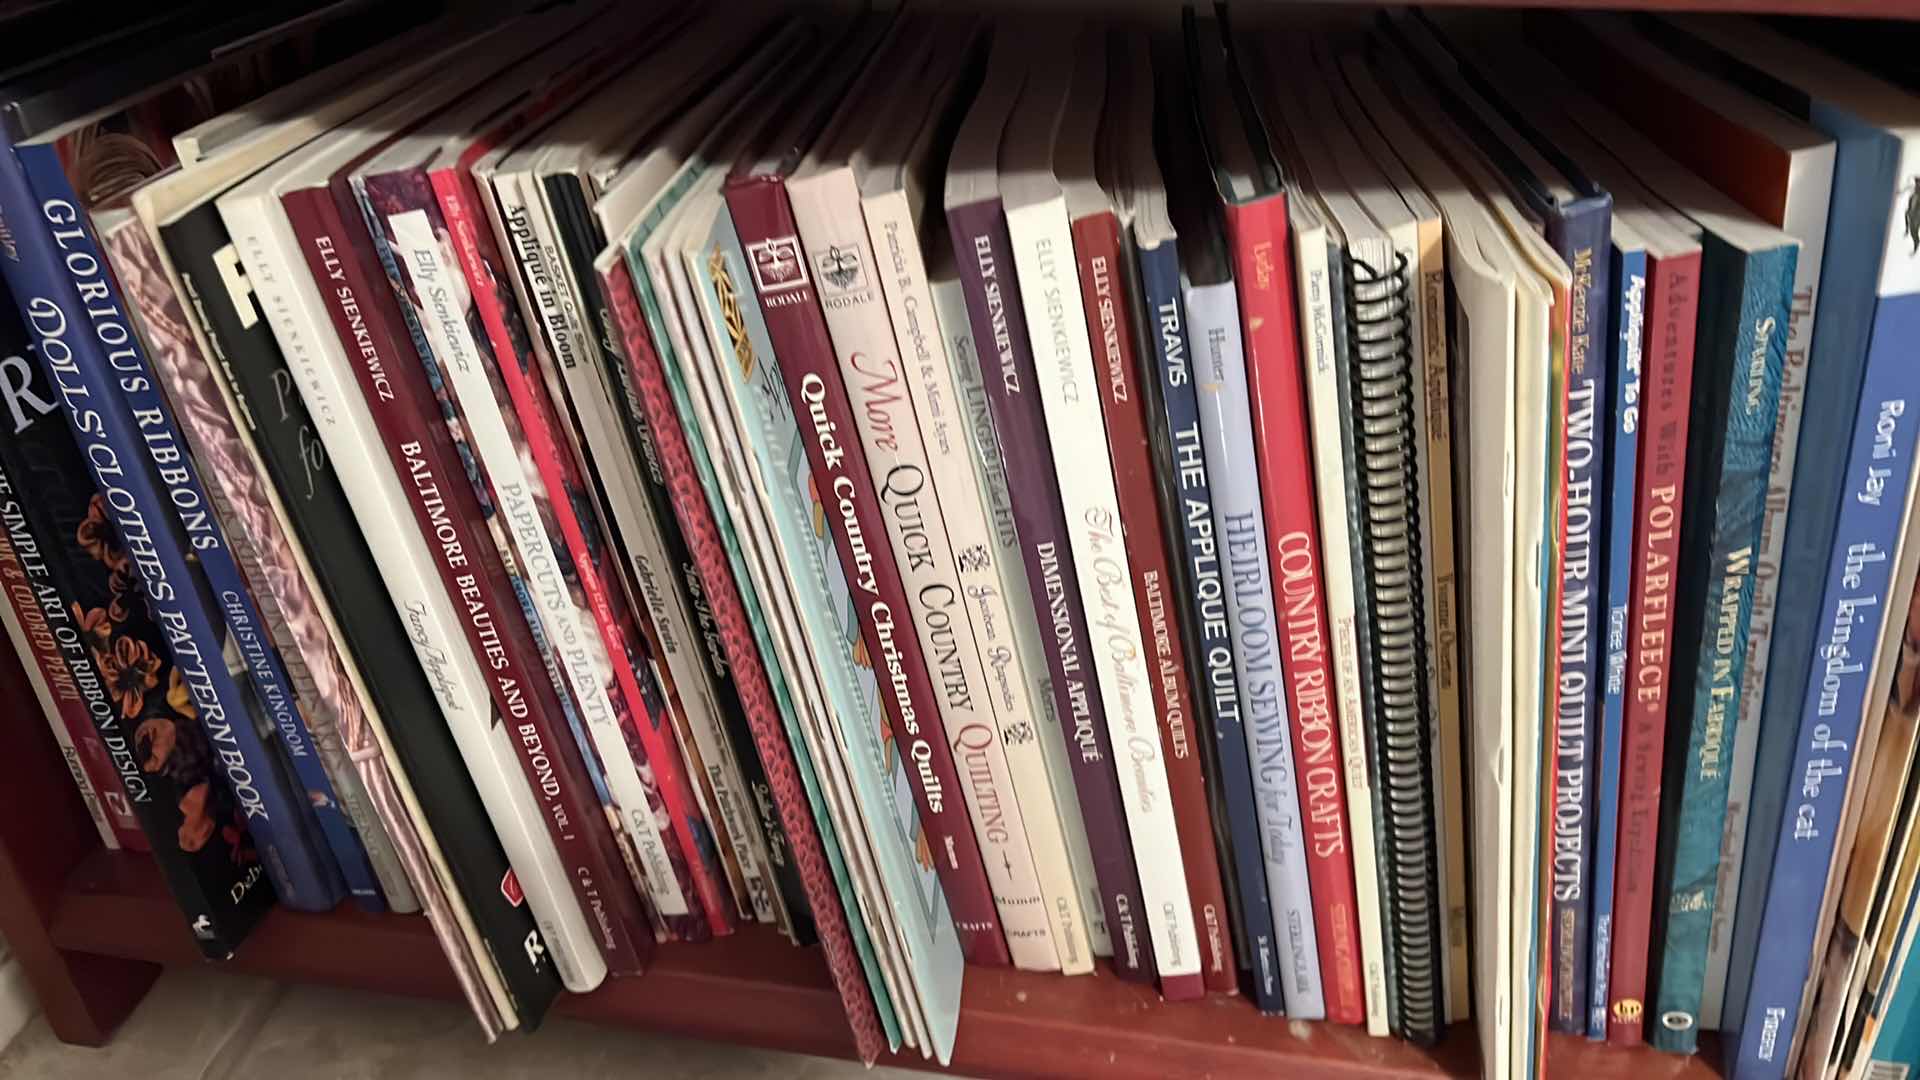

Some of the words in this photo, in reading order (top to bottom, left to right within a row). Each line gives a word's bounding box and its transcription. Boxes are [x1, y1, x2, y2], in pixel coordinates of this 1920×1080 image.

[413, 249, 437, 282] Elly
[540, 284, 558, 308] in
[975, 235, 997, 280] ELLY
[1036, 238, 1057, 282] ELLY
[1092, 256, 1111, 298] ELLY
[315, 235, 347, 282] ELLY
[336, 286, 394, 402] SIENKIEWICZ
[548, 313, 578, 370] Bloom
[984, 280, 1020, 397] SIENKIEWICZ
[1044, 286, 1079, 405] SIENKIEWICZ
[1098, 297, 1128, 405] SIENKIEWICZ
[1158, 297, 1187, 388] TRAVIS
[1786, 285, 1813, 341] The
[43, 199, 150, 393] GLORIOUS
[133, 407, 219, 550] RIBBONS
[850, 352, 902, 452] More
[966, 384, 1005, 487] LINGERIE
[1176, 421, 1206, 490] THE
[1872, 399, 1906, 460] Roni
[1563, 378, 1595, 581] TWO-HOUR
[1857, 464, 1893, 507] Jay
[1085, 506, 1115, 553] The
[1186, 499, 1227, 640] APPLIQUE
[1842, 541, 1887, 590] the
[88, 443, 175, 601] CLOTHES
[159, 609, 237, 745] PATTERN
[218, 748, 270, 824] BOOK
[401, 440, 468, 569] BALTIMORE
[456, 574, 509, 670] BEAUTIES
[498, 676, 528, 719] AND
[518, 723, 560, 801] BEYOND,
[502, 483, 566, 611] PAPERCUTS
[555, 614, 577, 646] AND
[570, 646, 611, 726] PLENTY
[801, 373, 846, 471] Quick
[834, 476, 880, 597] Country
[871, 602, 919, 736] Christmas
[911, 739, 943, 814] Quilts
[1037, 541, 1081, 677] DIMENSIONAL
[1093, 558, 1123, 614] Best
[1225, 511, 1273, 673] HEIRLOOM
[1278, 531, 1323, 663] COUNTRY
[1561, 586, 1590, 664] MINI
[1717, 545, 1752, 655] WRAPPED
[1, 500, 49, 578] SIMPLE
[34, 581, 70, 623] ART
[55, 626, 84, 655] OF
[70, 658, 119, 731] RIBBON
[105, 736, 153, 802] DESIGN
[222, 590, 273, 680] CHRISTINE
[263, 683, 308, 757] KINGDOM
[1108, 634, 1139, 734] Baltimore
[1144, 569, 1172, 657] BALTIMORE
[1166, 708, 1189, 760] QUILTS
[1208, 646, 1240, 723] QUILT
[1712, 657, 1732, 682] IN
[1817, 594, 1878, 717] kingdom
[1248, 680, 1288, 785] SEWING
[1294, 668, 1334, 765] RIBBON
[1558, 671, 1587, 762] QUILT
[1811, 722, 1848, 752] of
[1128, 736, 1156, 814] Beauties
[1306, 766, 1345, 858] CRAFTS
[1794, 803, 1820, 841] cat
[1802, 758, 1843, 798] the
[1553, 768, 1584, 901] PROJECTS
